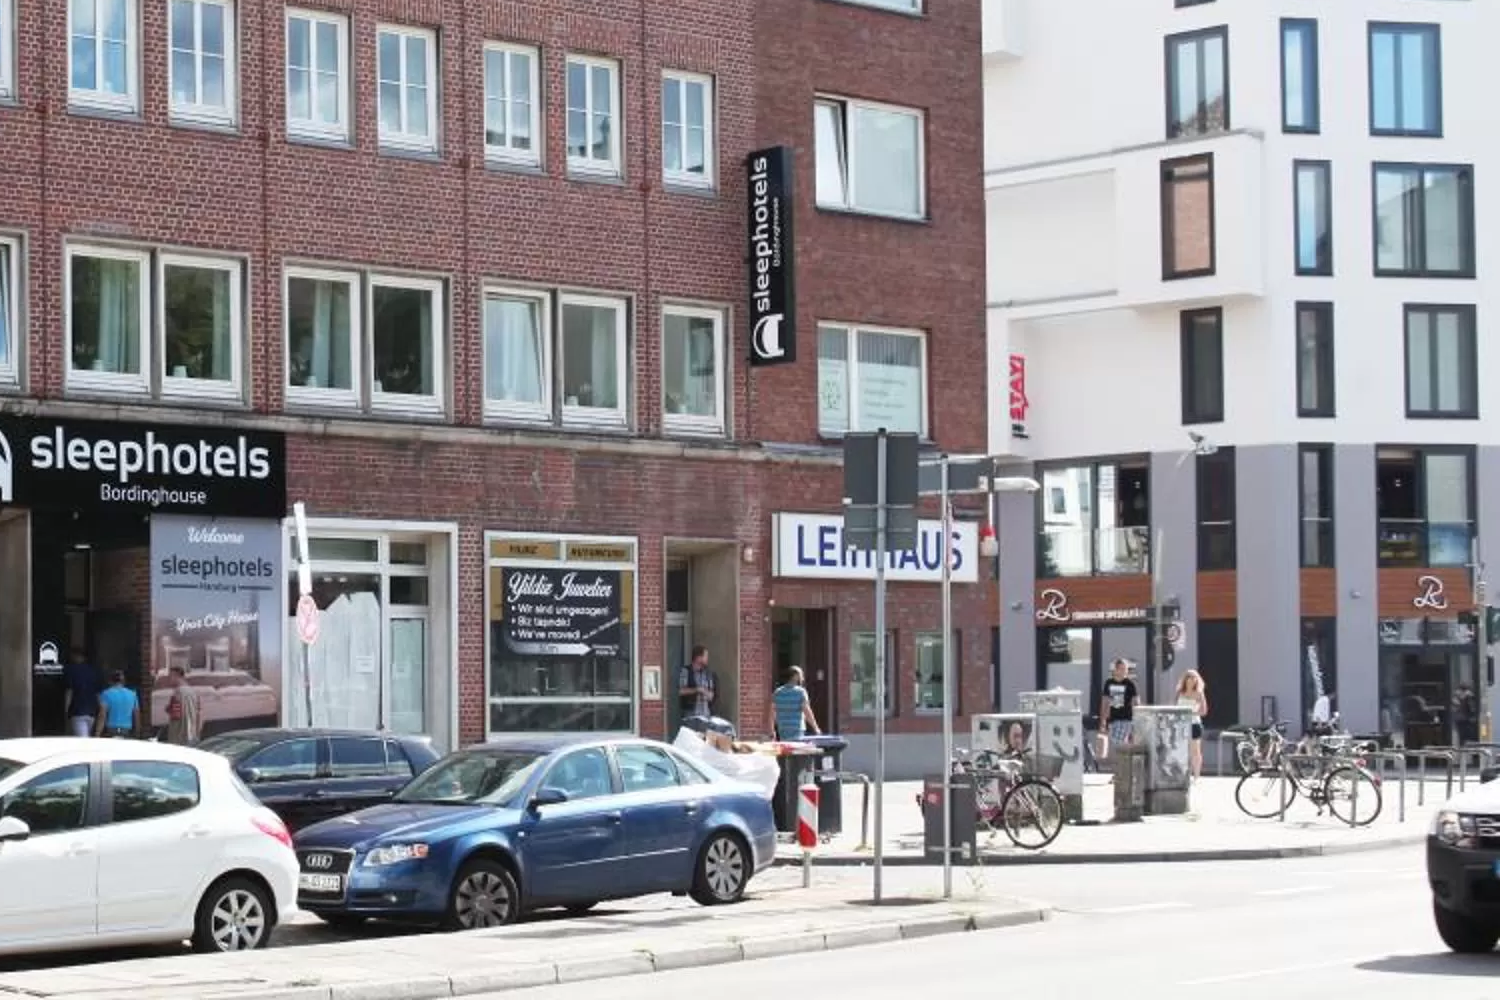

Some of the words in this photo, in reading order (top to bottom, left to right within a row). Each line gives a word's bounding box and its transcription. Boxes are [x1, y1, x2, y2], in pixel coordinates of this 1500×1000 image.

[750, 156, 773, 313] sleephotels
[30, 426, 270, 482] sleephotels
[100, 483, 207, 505] Bordinghouse
[187, 526, 244, 544] Welcome
[161, 554, 273, 580] sleephotels
[518, 604, 533, 614] Wir
[535, 605, 553, 615] sind
